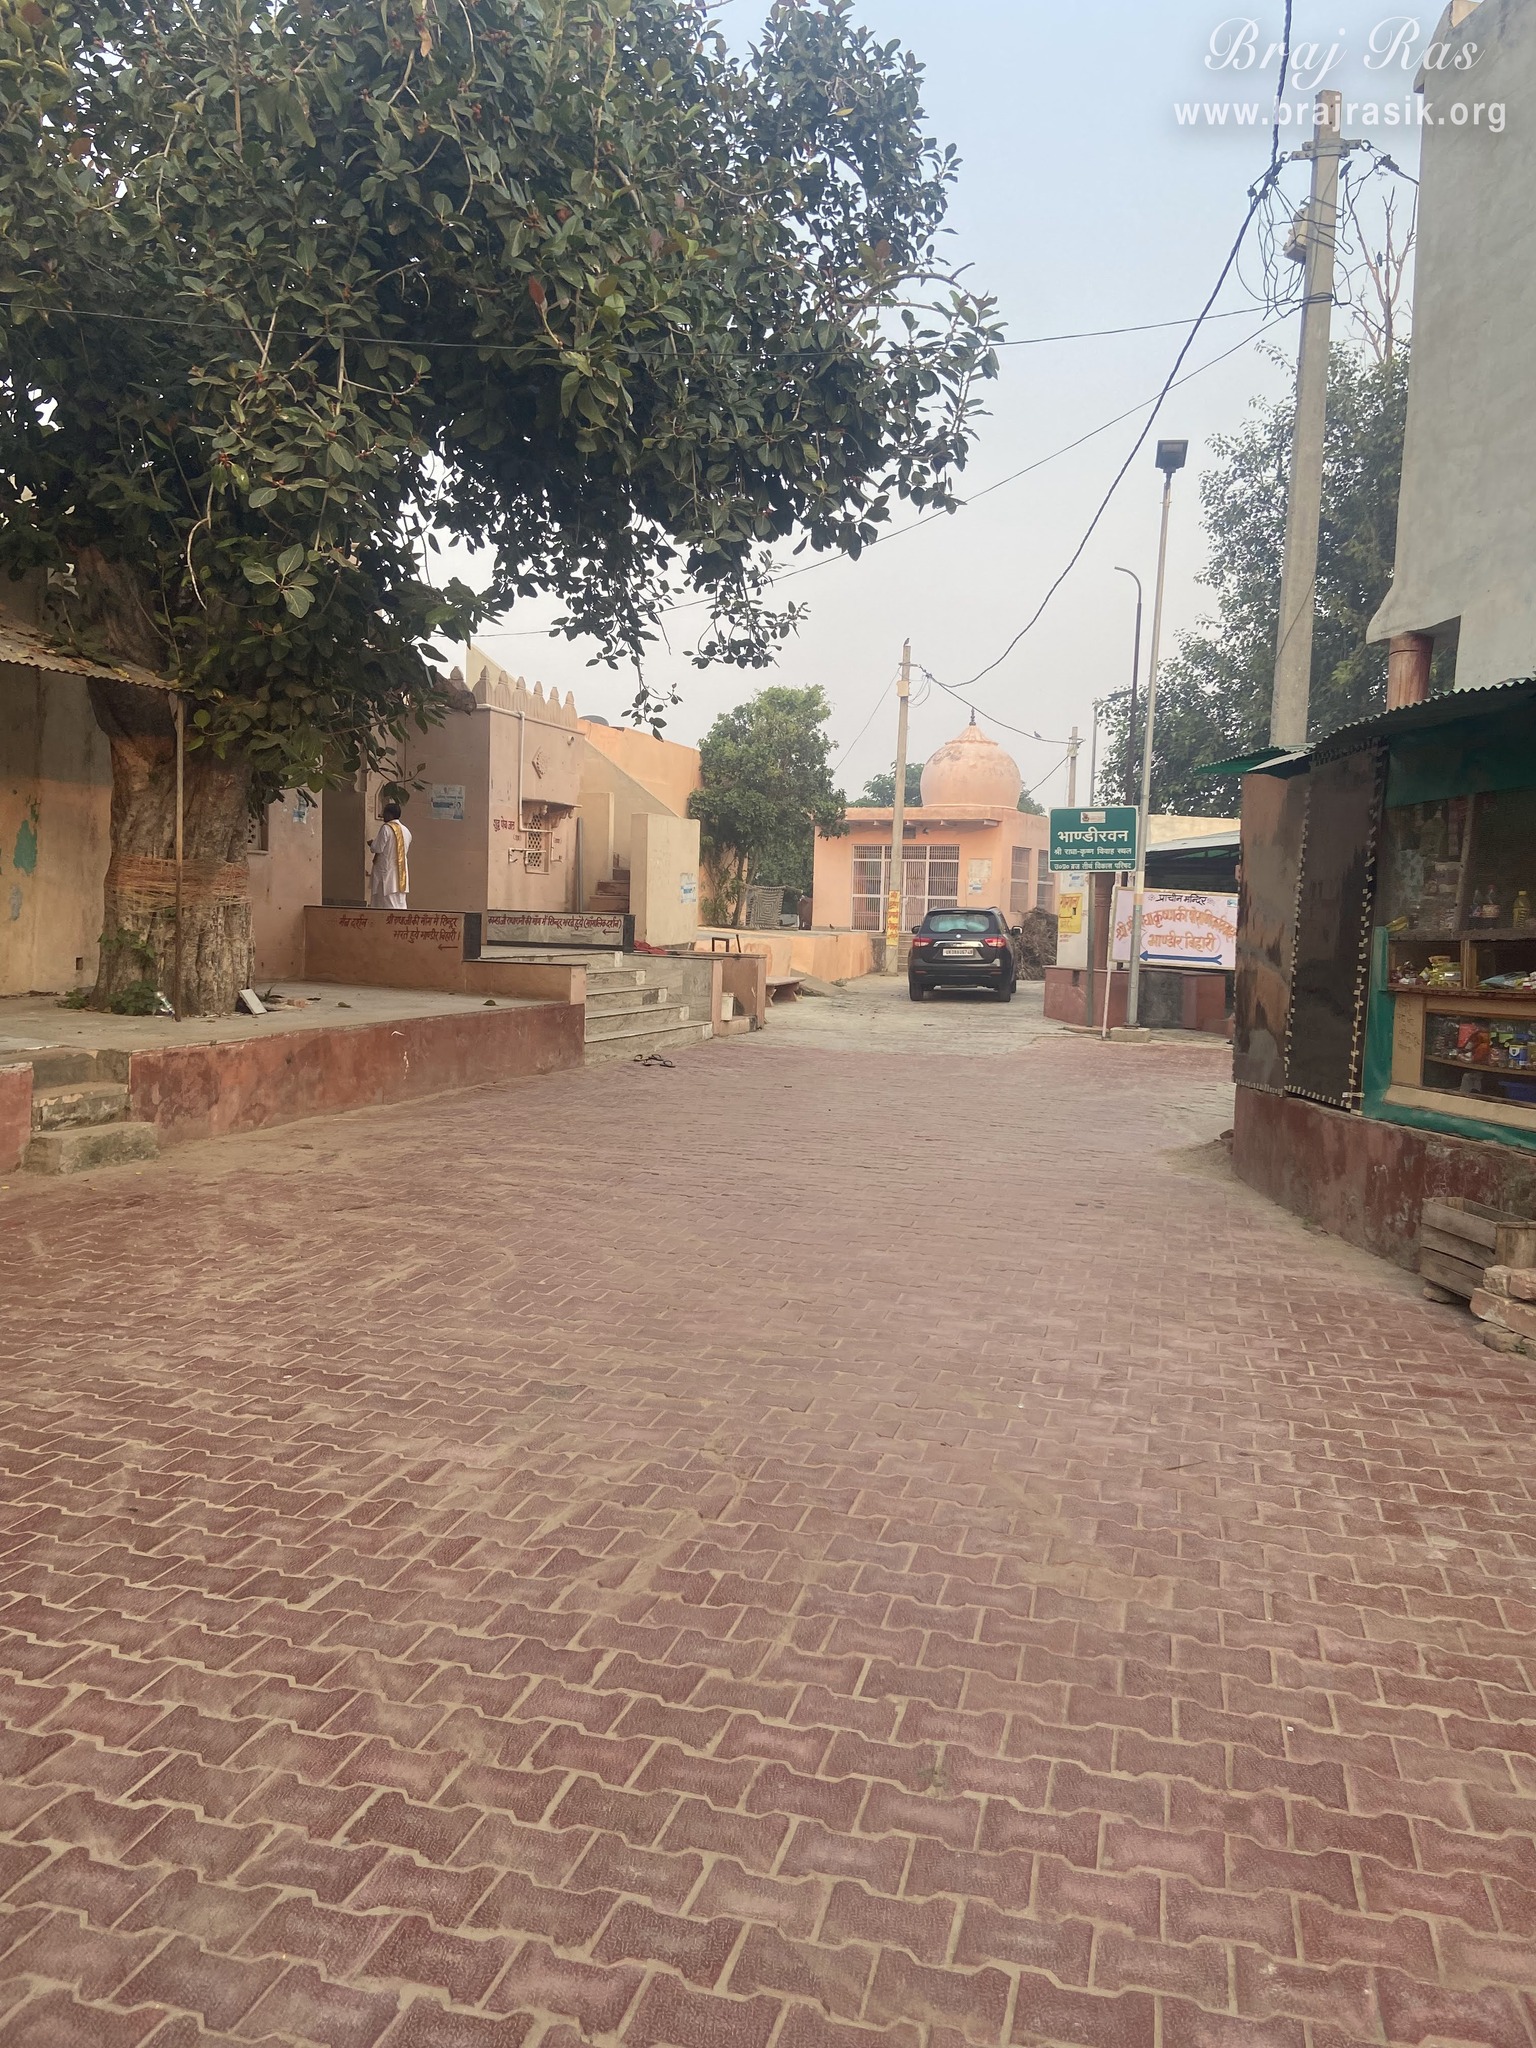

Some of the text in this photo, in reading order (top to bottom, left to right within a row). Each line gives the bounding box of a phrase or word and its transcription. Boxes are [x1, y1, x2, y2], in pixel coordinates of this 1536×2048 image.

[1058, 826, 1128, 842] भाण्डीरवन
[1054, 847, 1062, 855] श्री
[1097, 846, 1115, 856] विवाह
[1117, 847, 1132, 855] स्थल
[1094, 861, 1113, 870] विकास
[1155, 892, 1208, 906] प्राचीन मन्दिर
